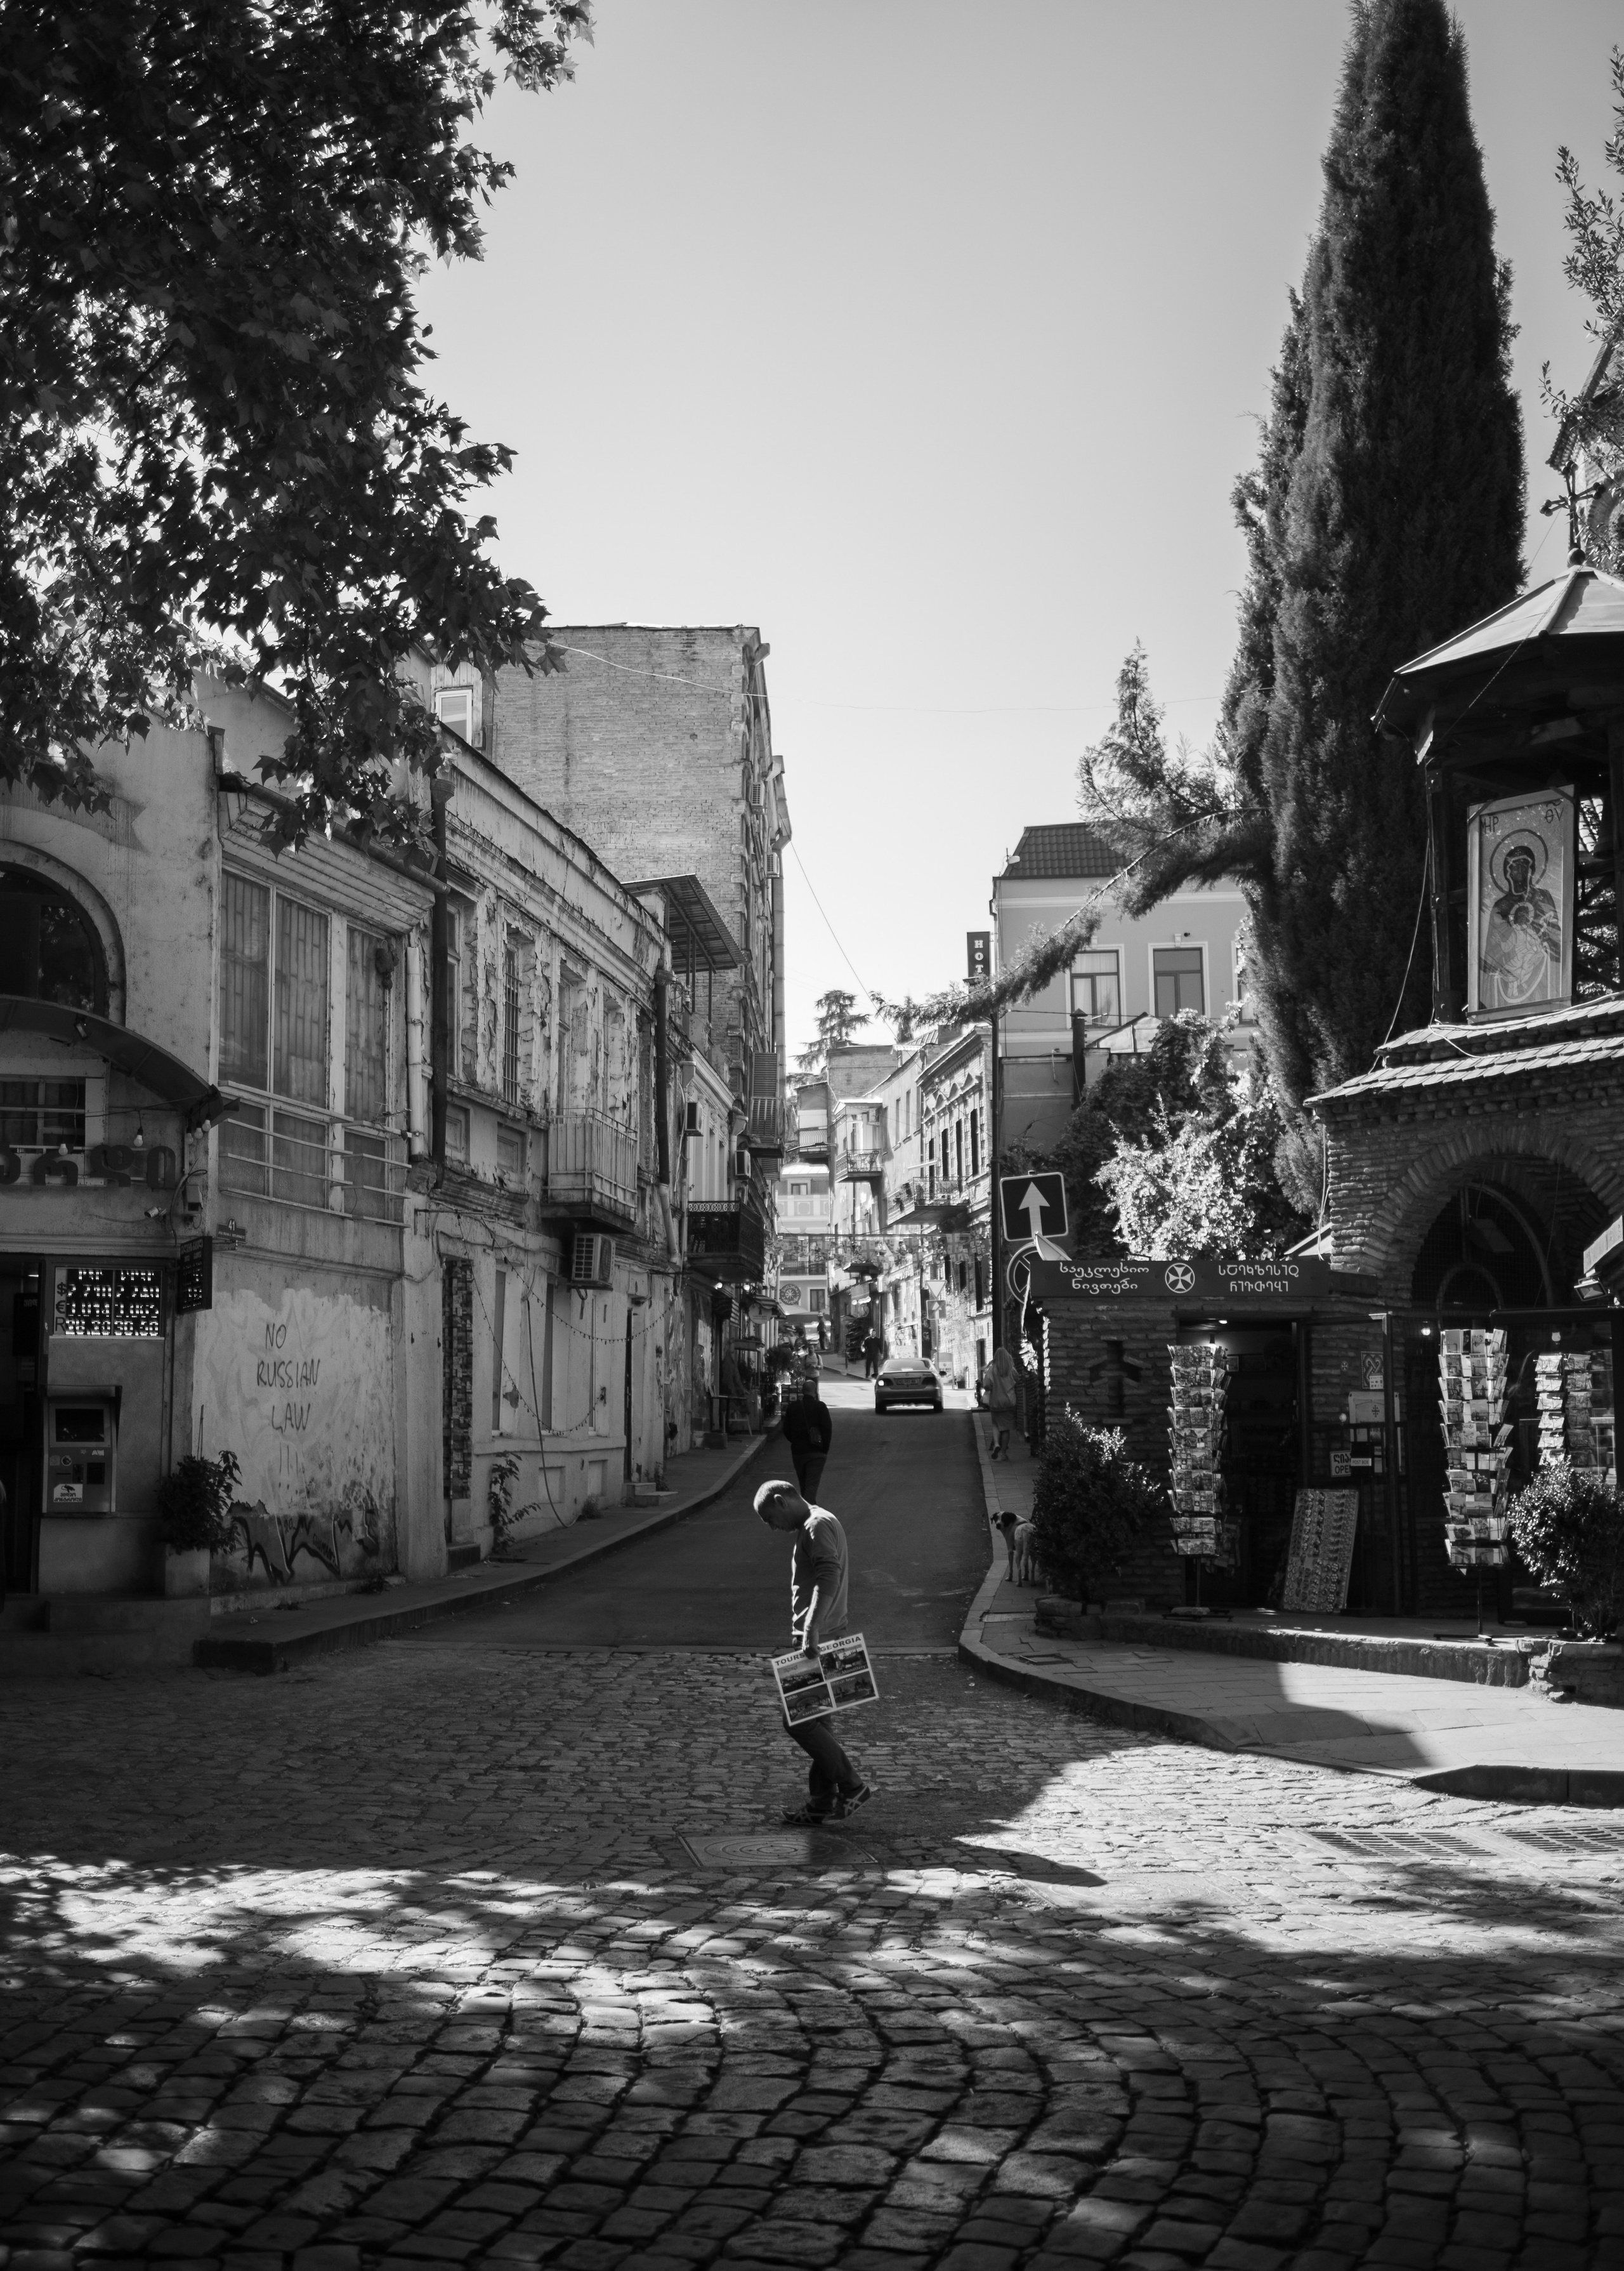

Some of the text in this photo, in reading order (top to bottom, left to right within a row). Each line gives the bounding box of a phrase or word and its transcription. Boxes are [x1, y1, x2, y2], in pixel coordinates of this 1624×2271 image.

[228, 1220, 235, 1231] 41
[1059, 1262, 1149, 1278] საეკლესიო
[1072, 1278, 1137, 1294] ნივთები
[266, 1323, 287, 1349] NO
[257, 1359, 320, 1388] RUSSIAN
[272, 1403, 311, 1433] LAW
[1335, 1465, 1351, 1474] OPE
[776, 1653, 805, 1666] TOURS
[821, 1636, 861, 1652] GEORGIA
